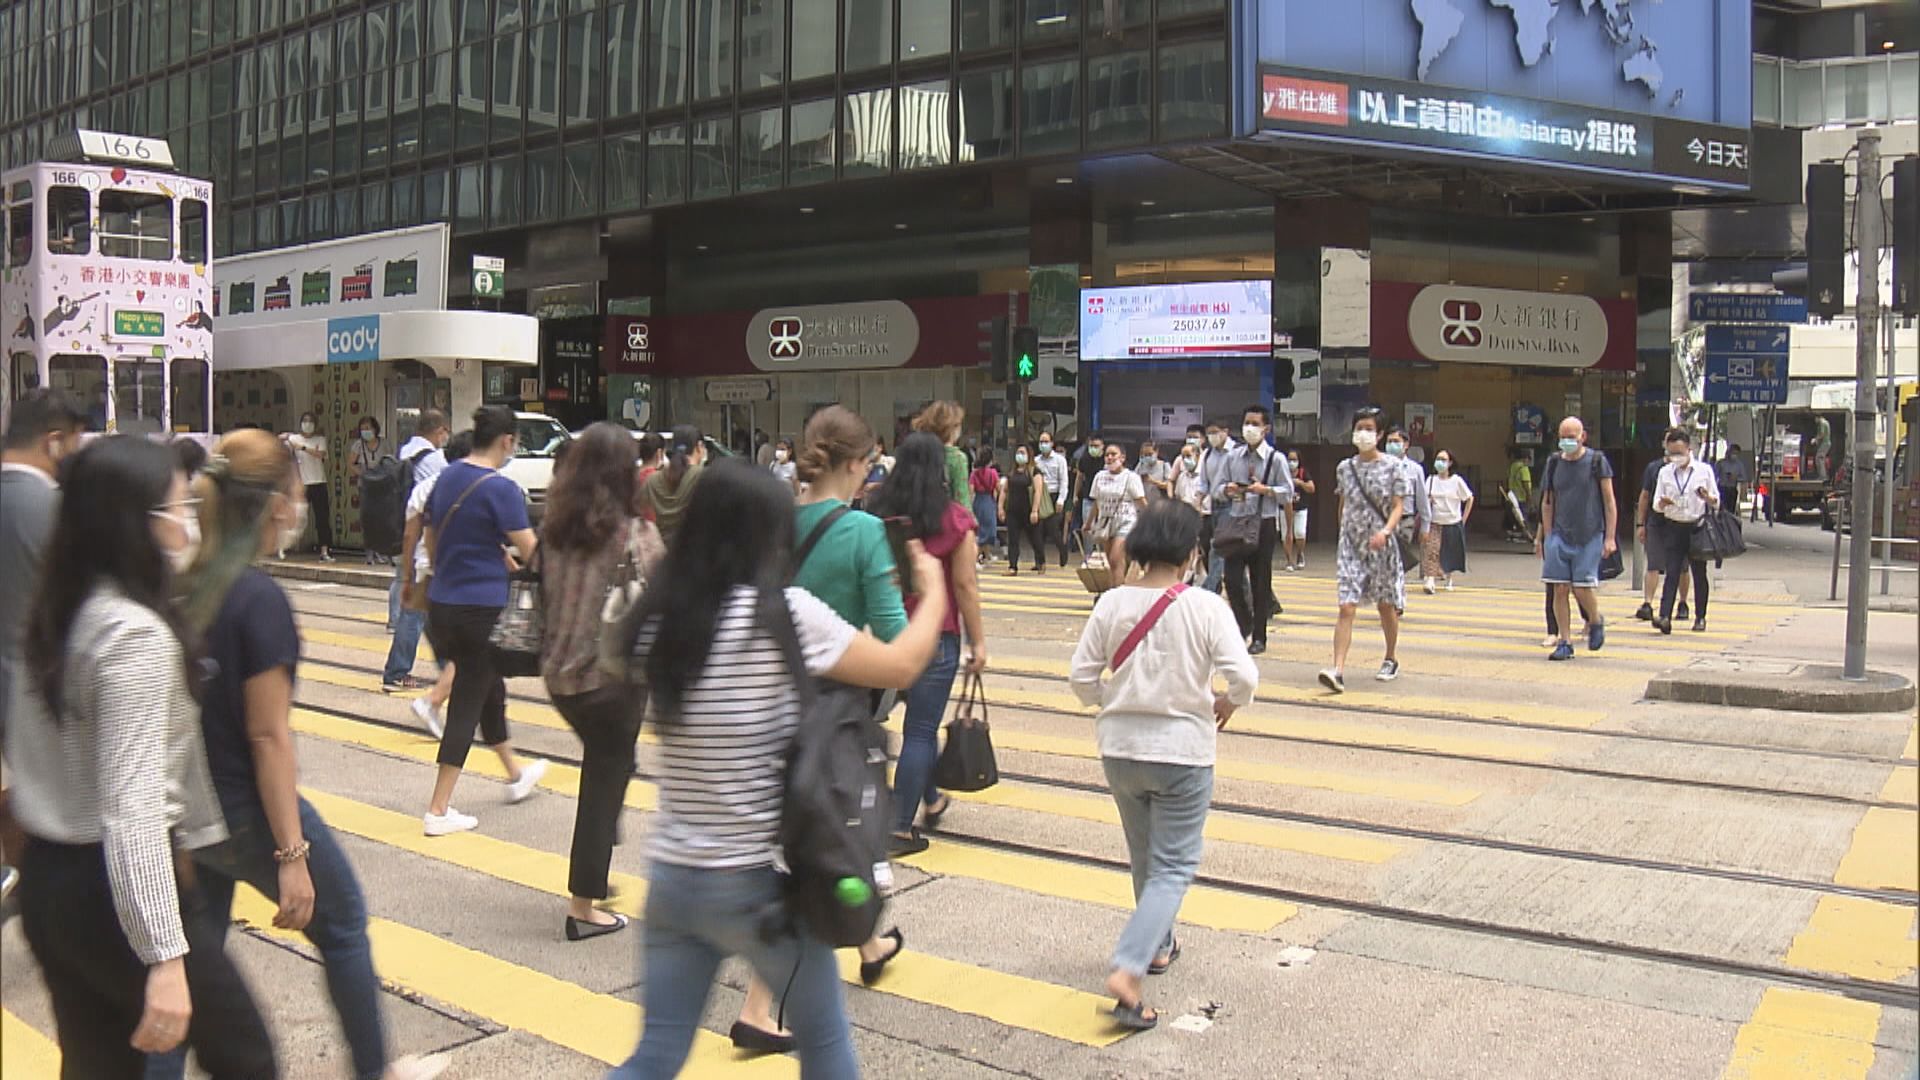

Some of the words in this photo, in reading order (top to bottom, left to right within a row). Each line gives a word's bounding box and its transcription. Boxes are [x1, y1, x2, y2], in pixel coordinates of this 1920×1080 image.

[1278, 87, 1338, 115] 雅仕維
[102, 135, 151, 159] 166
[51, 171, 76, 184] 166
[193, 186, 209, 200] 166
[80, 265, 190, 289] 香港小交響樂團
[1213, 301, 1230, 314] HSI
[1775, 297, 1803, 306] Station
[118, 311, 141, 323] Happy
[1493, 303, 1581, 331] 大新銀行
[1173, 318, 1226, 331] 25037.69
[329, 325, 378, 353] cody
